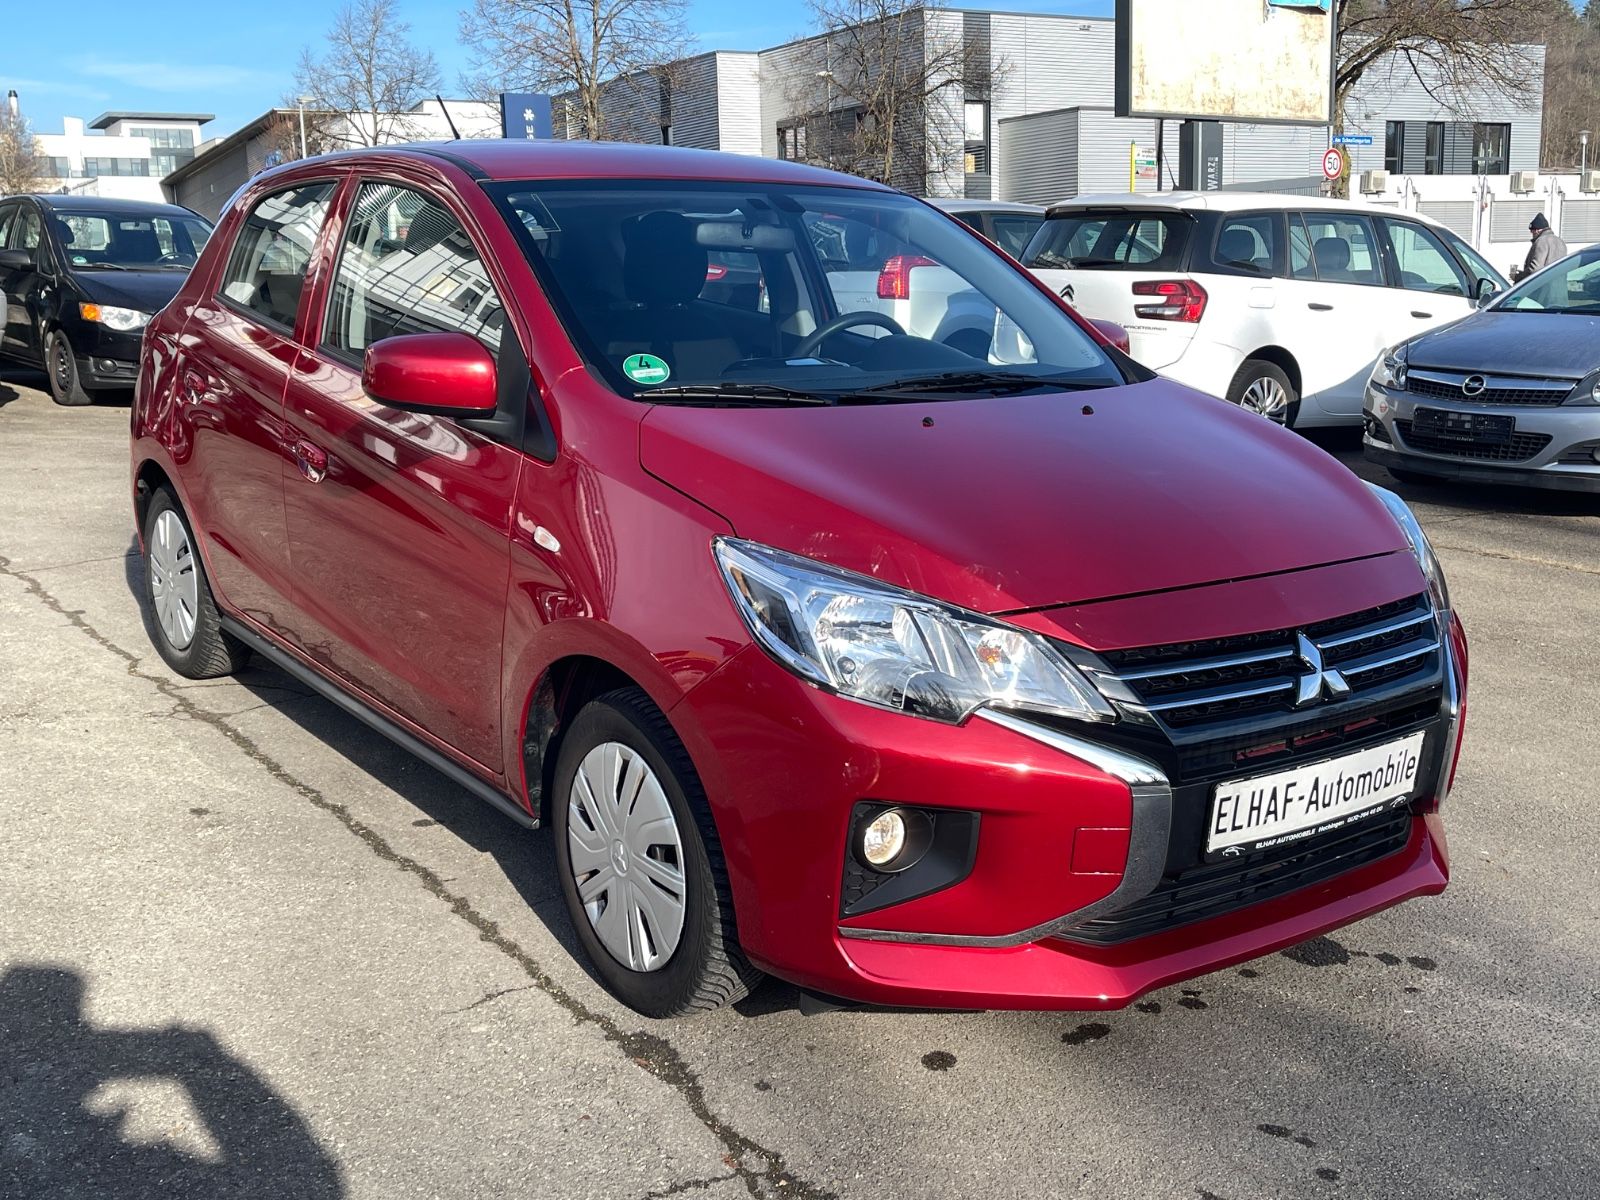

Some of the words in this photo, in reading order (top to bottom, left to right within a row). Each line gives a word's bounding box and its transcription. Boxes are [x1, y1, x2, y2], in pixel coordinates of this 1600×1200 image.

[1328, 157, 1338, 170] 50
[639, 355, 651, 368] 4
[1215, 749, 1416, 835] ELHAF-Automobile
[1255, 838, 1276, 849] ELHAF
[1276, 828, 1316, 844] AUTOMOBILE
